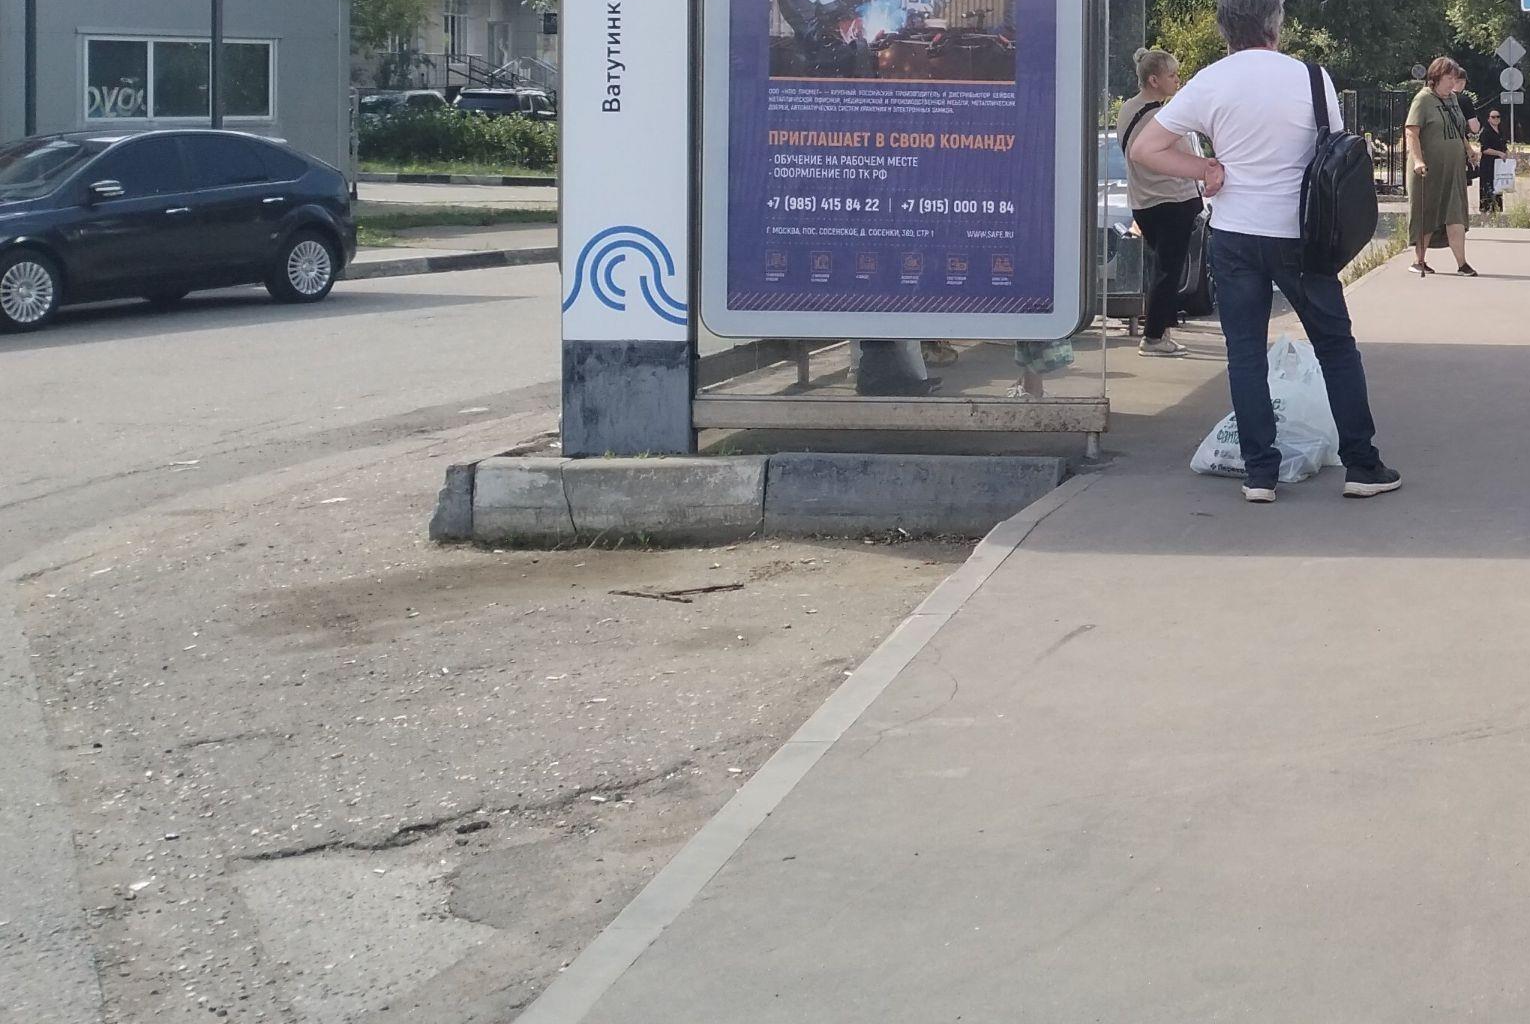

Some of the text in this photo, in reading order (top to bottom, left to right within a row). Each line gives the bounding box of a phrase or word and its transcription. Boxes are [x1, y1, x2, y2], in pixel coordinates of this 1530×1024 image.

[768, 130, 1015, 151] ПРИГЛАШАЕТ В СВОЮ КОМАНДУ
[774, 154, 918, 167] ОБУЧЕНИЕ НА РАБОЧЕМ МЕСТЕ
[773, 167, 887, 180] ОФОРМЛЕНИЕ ПО ТК РФ
[767, 195, 880, 212] +7 (985) 415 84 22
[901, 197, 1014, 214] +7 (915) 000 19 84
[802, 227, 818, 235] ПОС.
